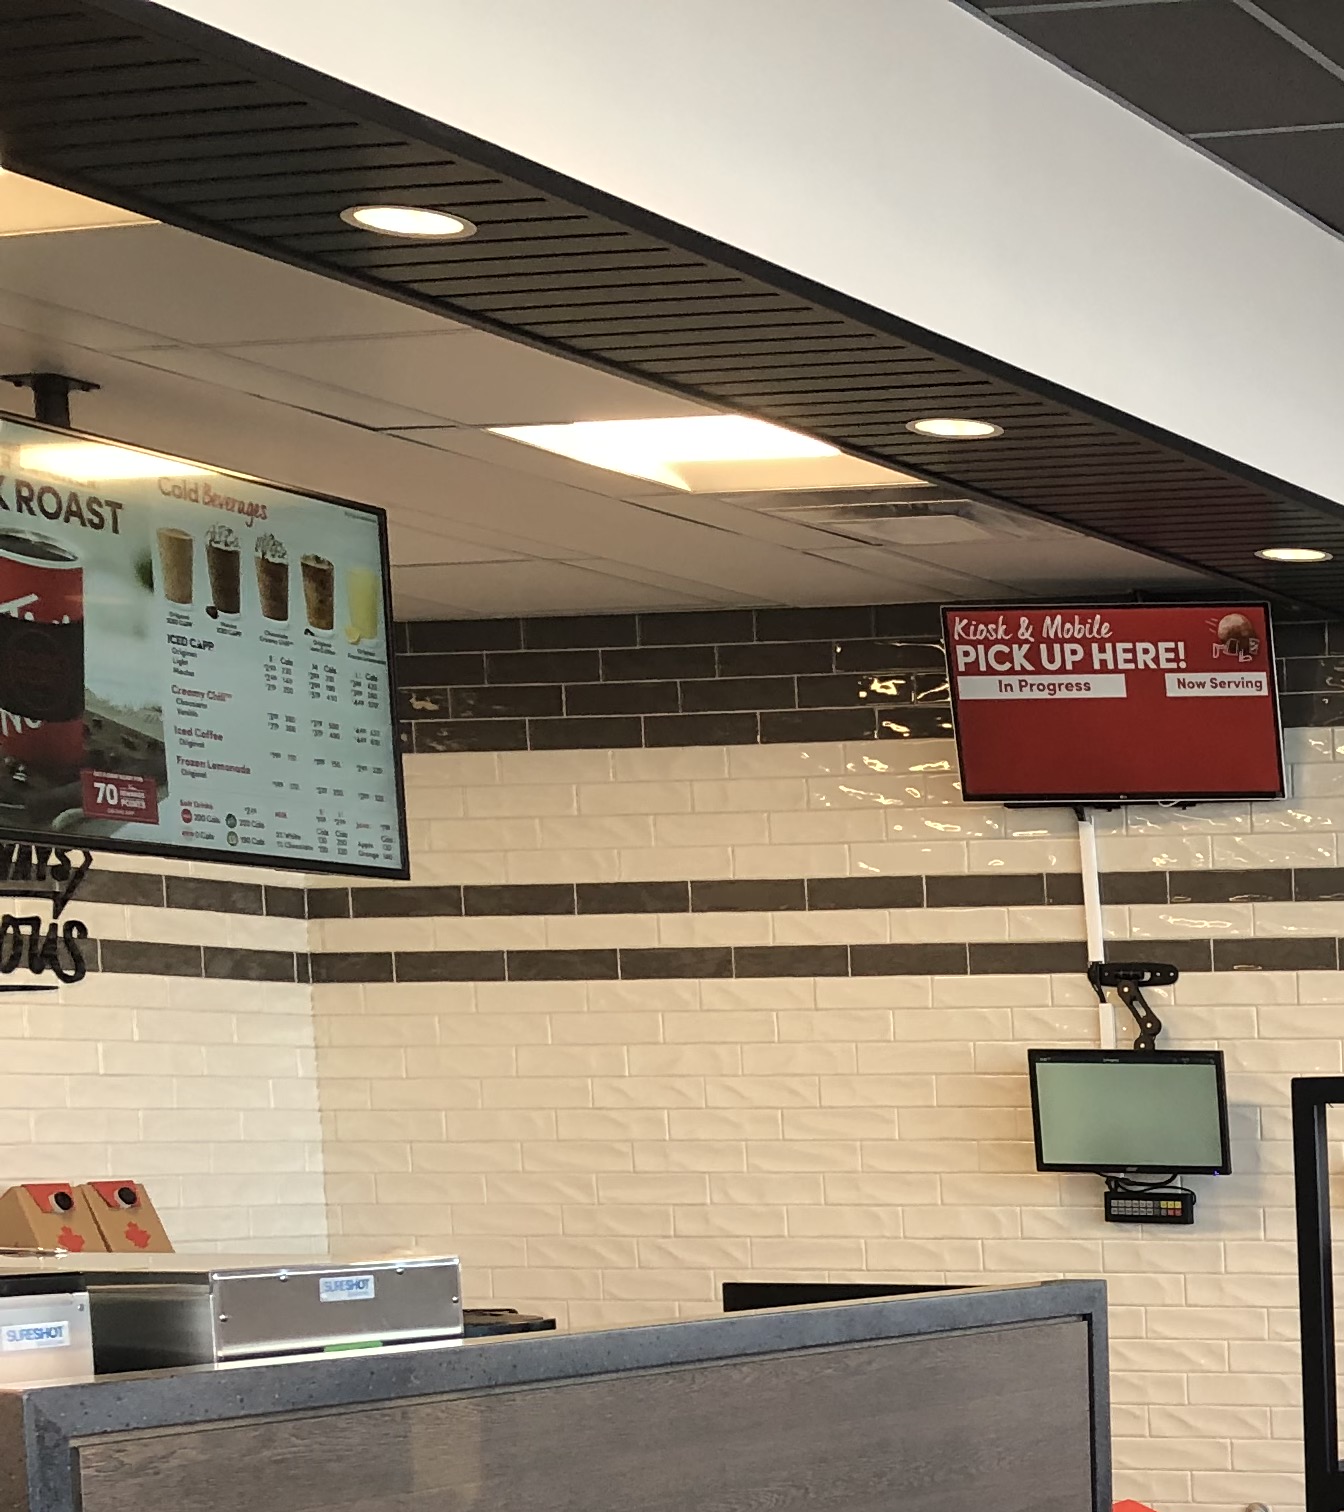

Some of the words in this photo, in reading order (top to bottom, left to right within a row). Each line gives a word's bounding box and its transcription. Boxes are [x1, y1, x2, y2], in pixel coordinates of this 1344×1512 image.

[15, 479, 124, 534] ROAST
[158, 477, 199, 503] Cold
[202, 482, 268, 528] Beverages
[954, 616, 1012, 641] Kiosk
[1017, 615, 1034, 642] &
[1042, 614, 1113, 640] Mobile
[167, 634, 188, 647] ICED
[189, 638, 215, 651] CAPP
[955, 644, 1035, 672] PICK
[1040, 643, 1085, 671] UP
[1092, 641, 1187, 670] HERE!
[998, 679, 1014, 693] In
[1018, 679, 1091, 696] Progress
[1176, 677, 1206, 690] Now
[1210, 677, 1263, 692] Serving
[174, 725, 193, 737] Iced
[194, 728, 223, 742] Coffee
[176, 755, 206, 769] Frozen
[207, 760, 251, 775] Lemonade
[93, 782, 118, 805] 70
[322, 1279, 370, 1292] SURESHOT
[6, 1327, 64, 1342] SURESHOT
